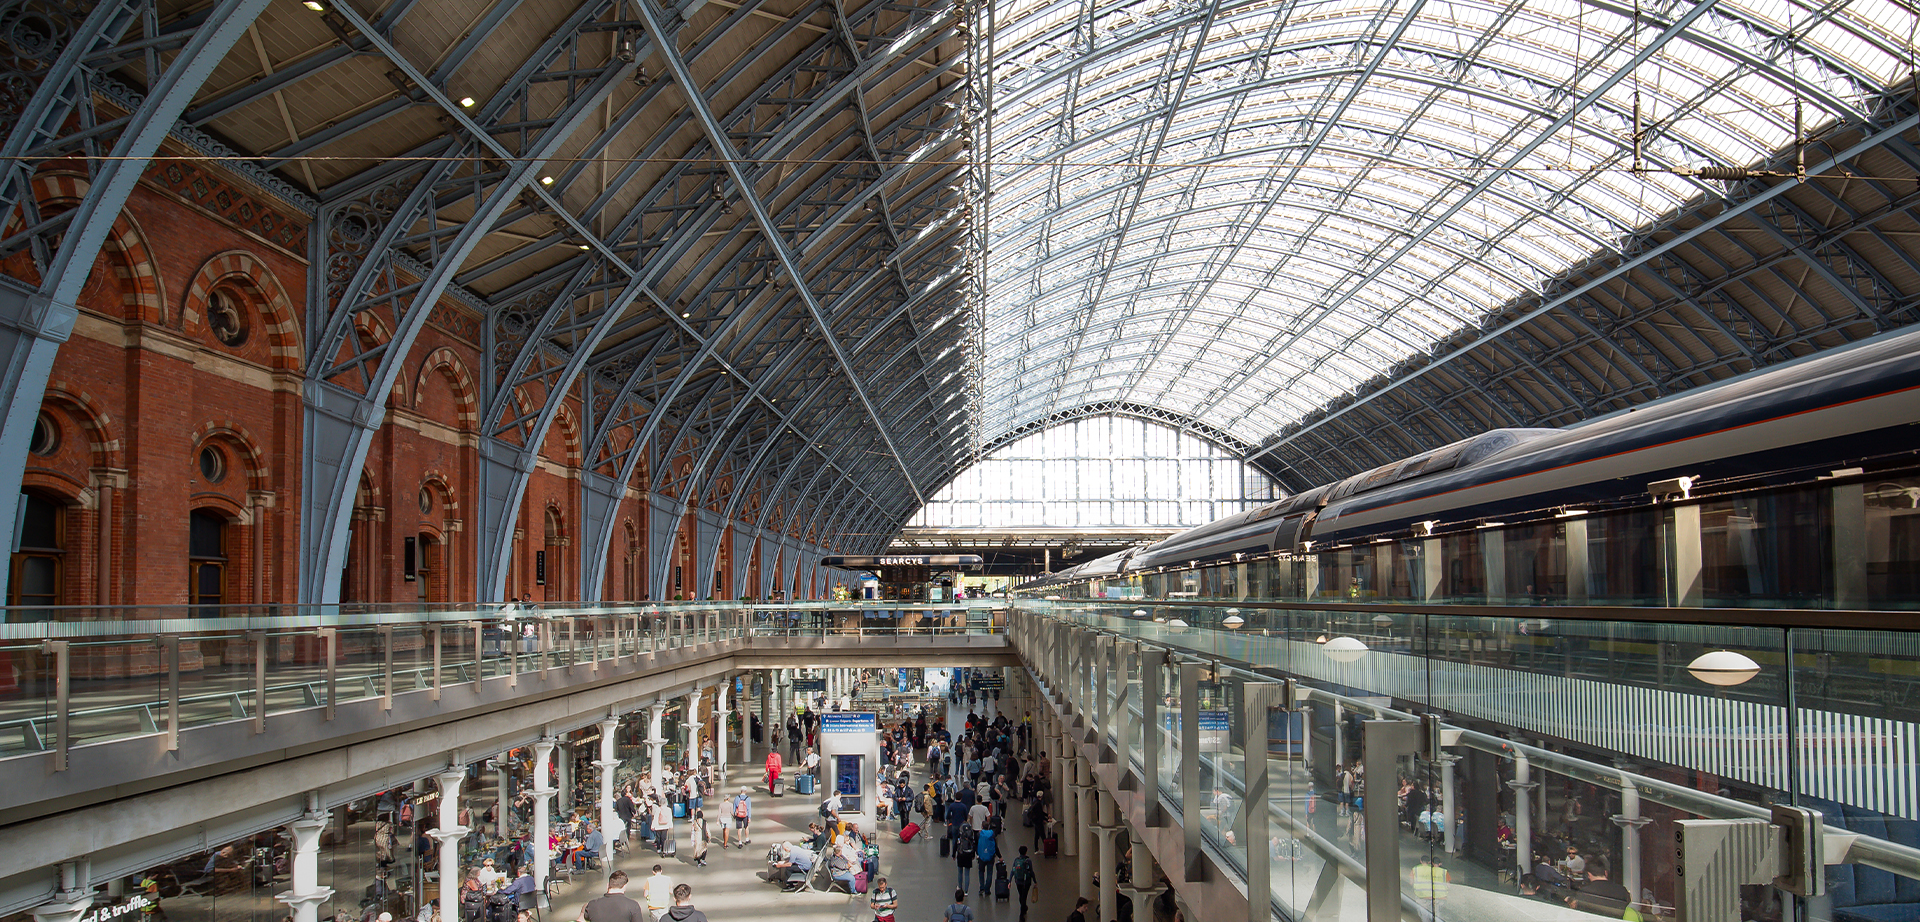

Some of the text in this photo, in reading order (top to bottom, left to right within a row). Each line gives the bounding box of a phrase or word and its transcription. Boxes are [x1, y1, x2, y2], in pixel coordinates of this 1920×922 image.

[416, 797, 423, 805] LE
[424, 792, 435, 803] PAIN
[100, 907, 113, 922] &
[112, 895, 152, 917] truffle.
